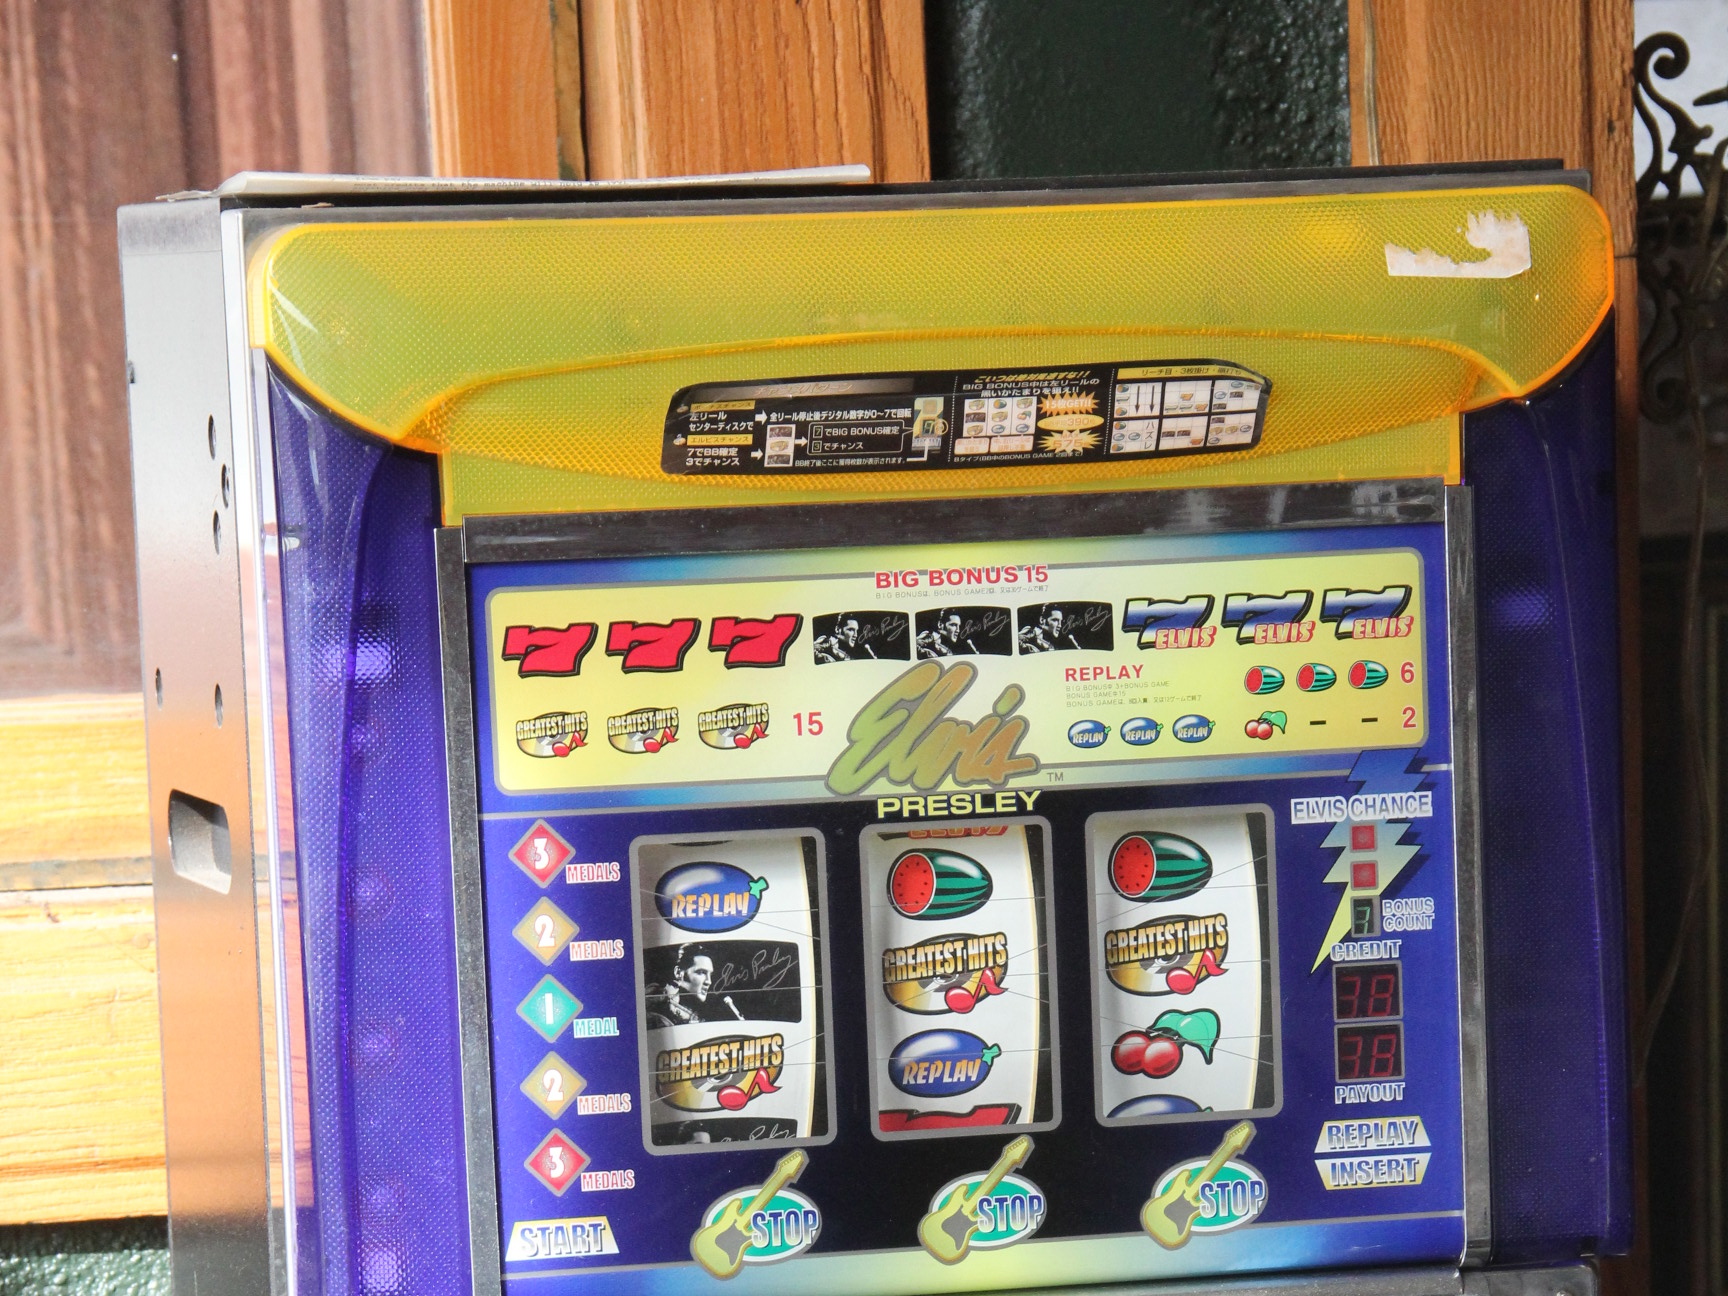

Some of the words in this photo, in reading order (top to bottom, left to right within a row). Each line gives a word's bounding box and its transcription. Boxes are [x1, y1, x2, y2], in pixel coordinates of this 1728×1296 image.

[689, 411, 727, 421] 左リール
[689, 421, 754, 432] センターディスクで
[685, 457, 740, 467] 3でチャンス
[875, 571, 920, 589] BIG
[928, 566, 1019, 587] BONUS
[1023, 564, 1049, 584] 15
[934, 588, 961, 597] BONUS
[1154, 624, 1218, 650] ELVIS
[1253, 619, 1316, 645] ELVIS
[1352, 615, 1415, 640] ELVIS
[1065, 664, 1144, 682] REPLAY
[1400, 661, 1416, 684] 6
[792, 712, 824, 737] 15
[1402, 706, 1418, 729] 2
[1072, 732, 1104, 743] REPLAY
[1125, 729, 1156, 741] REPLAY
[1177, 726, 1208, 738] REPLAY
[877, 789, 1041, 820] PRESLEY
[1292, 798, 1346, 823] ELVIS
[1350, 793, 1432, 820] CHANCE
[534, 839, 549, 869] 3
[566, 862, 620, 884] MEDALS
[671, 892, 750, 919] REPLAY
[1383, 898, 1434, 914] BONUS
[535, 918, 557, 949] 2
[1383, 914, 1434, 931] COUNT
[569, 939, 624, 961] MEDALS
[1105, 922, 1185, 964] GREATEST
[1186, 913, 1229, 951] HITS
[1330, 939, 1402, 962] CREDIT
[883, 940, 964, 982] GREATEST
[965, 932, 1007, 968] HITS
[544, 992, 554, 1026] 1
[573, 1017, 620, 1038] MEDAL
[656, 1042, 740, 1084] GREATEST
[739, 1031, 784, 1068] HITS
[902, 1058, 982, 1086] REPLAY
[542, 1069, 565, 1102] 2
[1335, 1082, 1405, 1104] PAYOUT
[577, 1093, 632, 1115] MEDALS
[1327, 1119, 1419, 1150] REPLAY
[549, 1146, 566, 1179] 3
[1329, 1157, 1419, 1187] INSERT
[580, 1170, 635, 1192] MEDALS
[1199, 1179, 1265, 1220] STOP
[976, 1193, 1044, 1235] STOP
[519, 1219, 608, 1258] START
[751, 1208, 819, 1250] STOP
